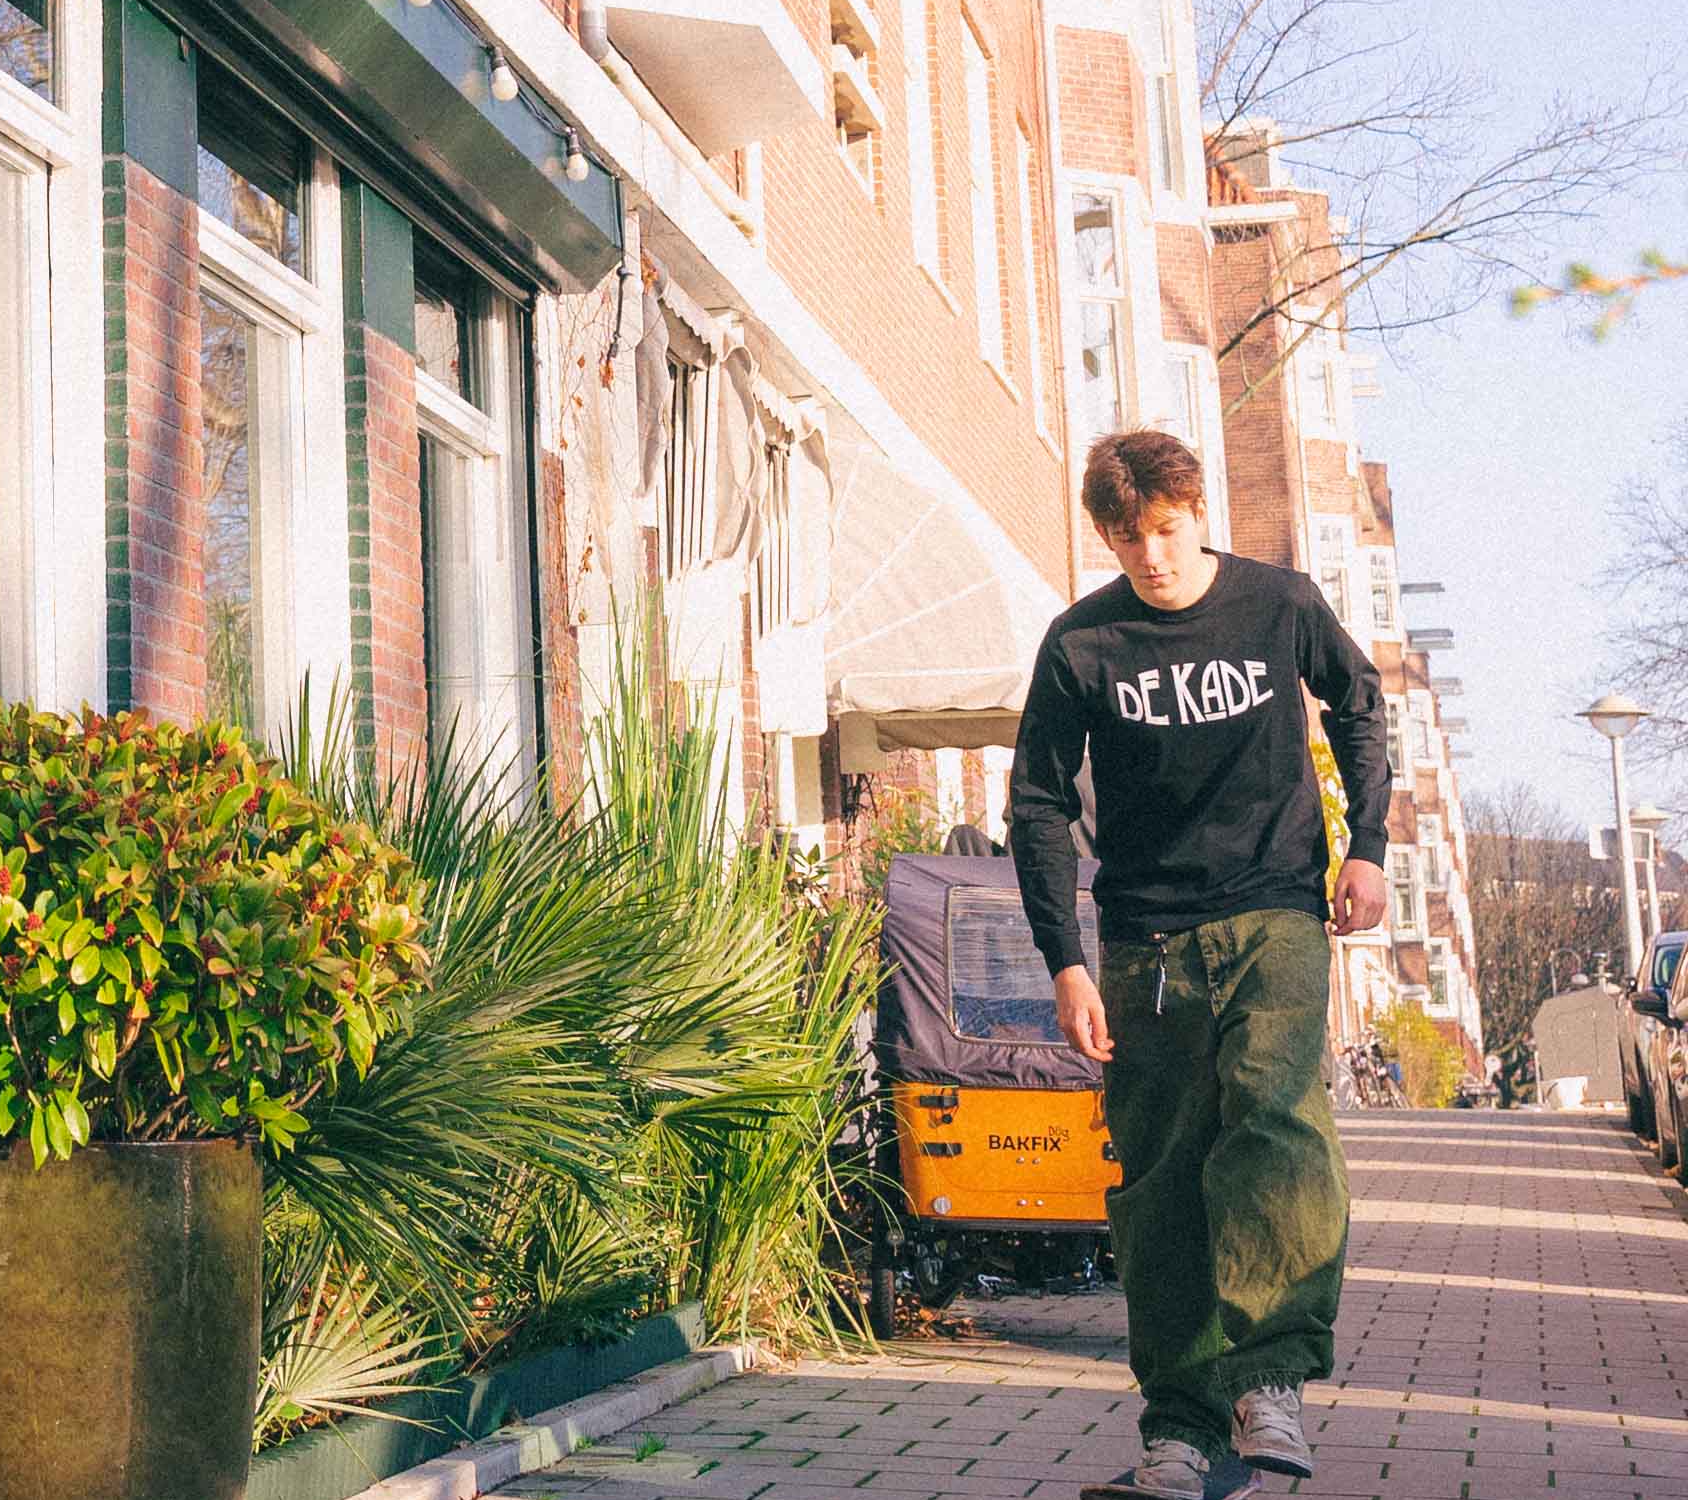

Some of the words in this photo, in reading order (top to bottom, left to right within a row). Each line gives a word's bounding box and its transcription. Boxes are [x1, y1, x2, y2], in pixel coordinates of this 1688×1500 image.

[1115, 668, 1170, 726] DE
[1170, 660, 1274, 726] KADE
[988, 1134, 1061, 1152] BAKFIX
